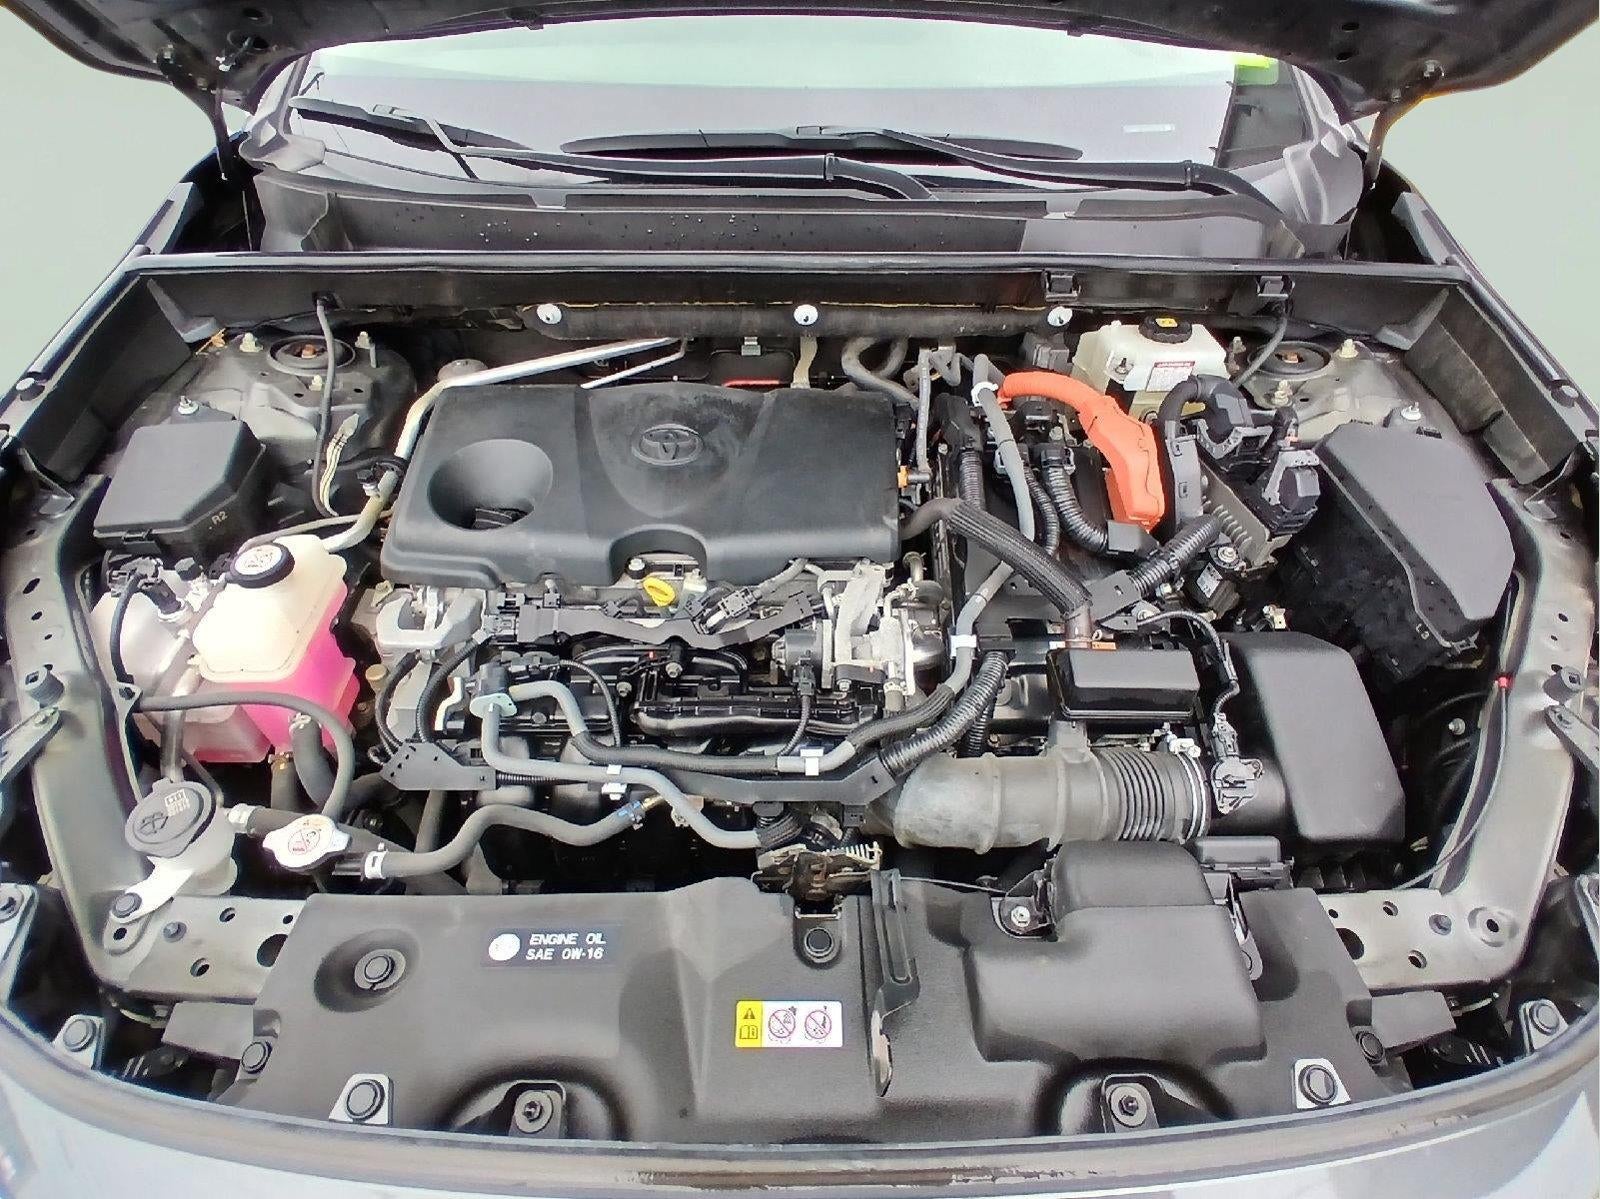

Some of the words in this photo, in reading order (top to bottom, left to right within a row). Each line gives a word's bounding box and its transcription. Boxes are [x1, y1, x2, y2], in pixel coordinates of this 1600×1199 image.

[529, 932, 578, 946] ENGINE
[585, 932, 606, 945] OIL
[525, 948, 555, 961] SAE
[562, 947, 604, 960] 0W-16
